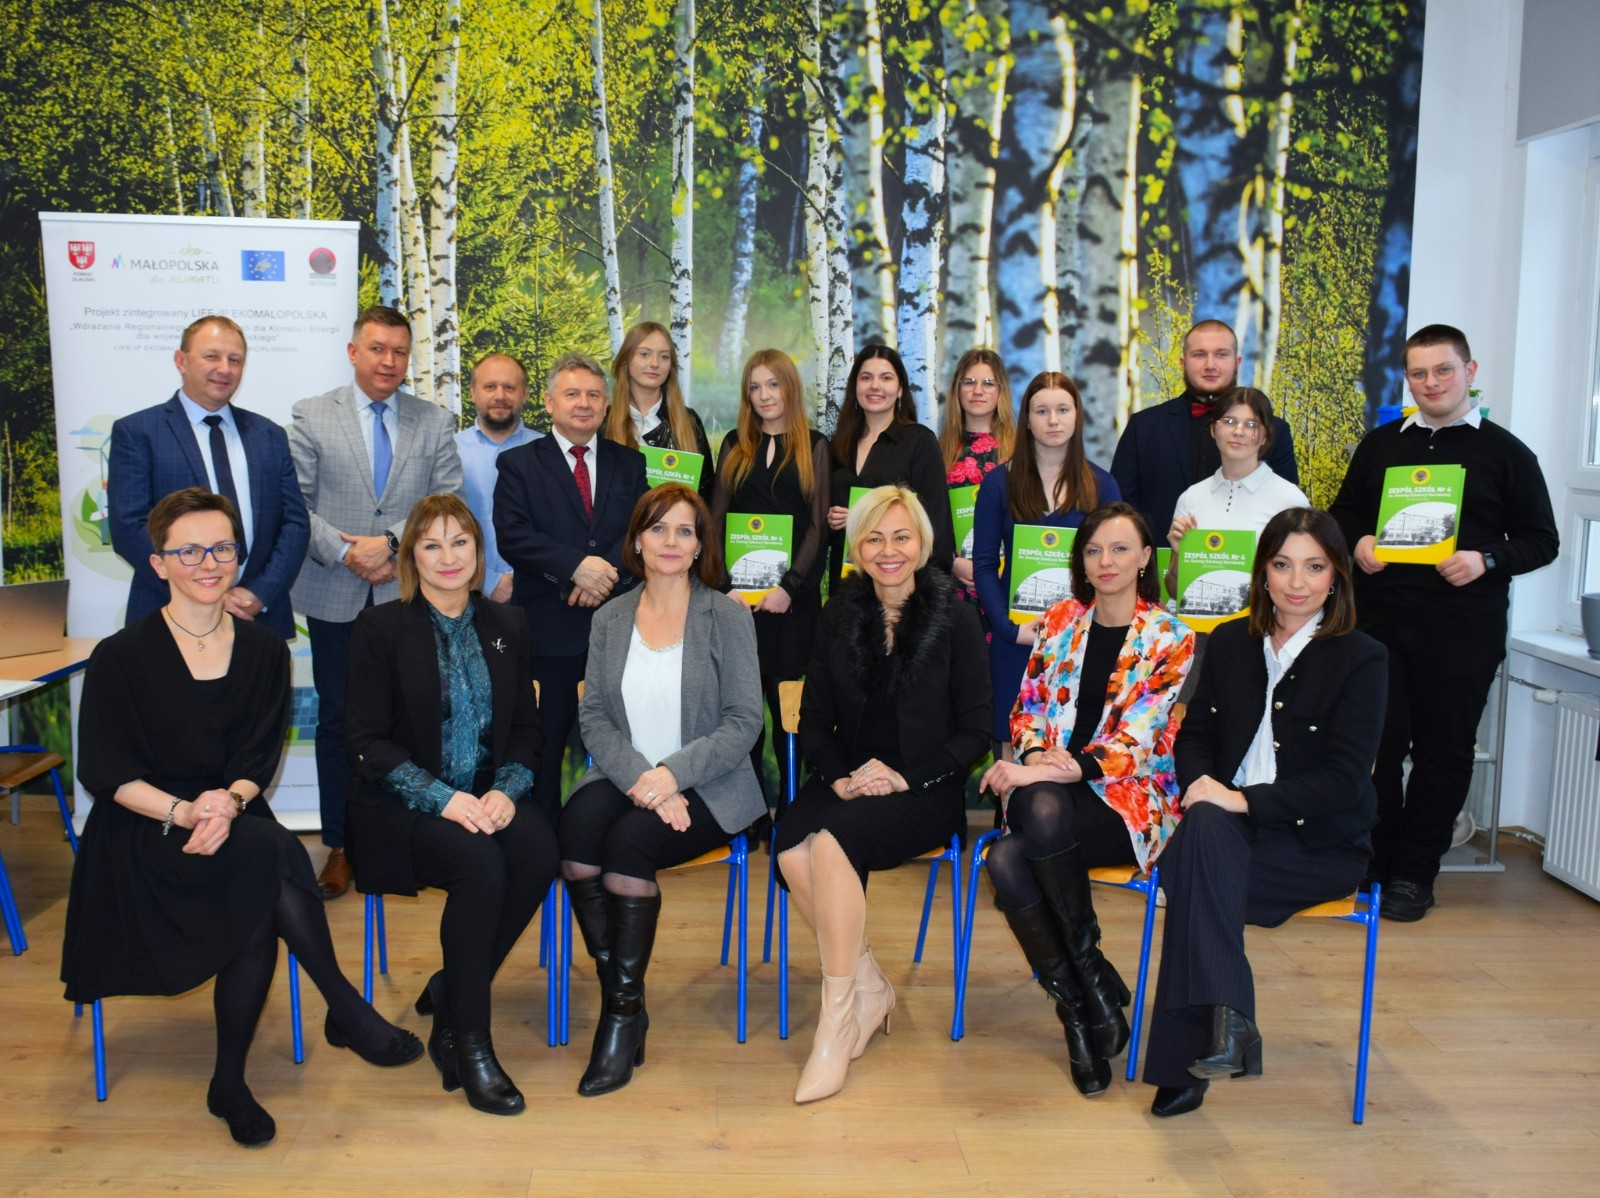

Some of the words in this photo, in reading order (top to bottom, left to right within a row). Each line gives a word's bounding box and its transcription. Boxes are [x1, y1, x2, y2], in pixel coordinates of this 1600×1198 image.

[130, 259, 220, 272] MAŁOPOLSKA
[84, 307, 120, 318] Projekt
[122, 308, 189, 318] zintegrowany
[956, 506, 975, 515] ZESPÓ
[1044, 550, 1065, 558] SZKÓŁ
